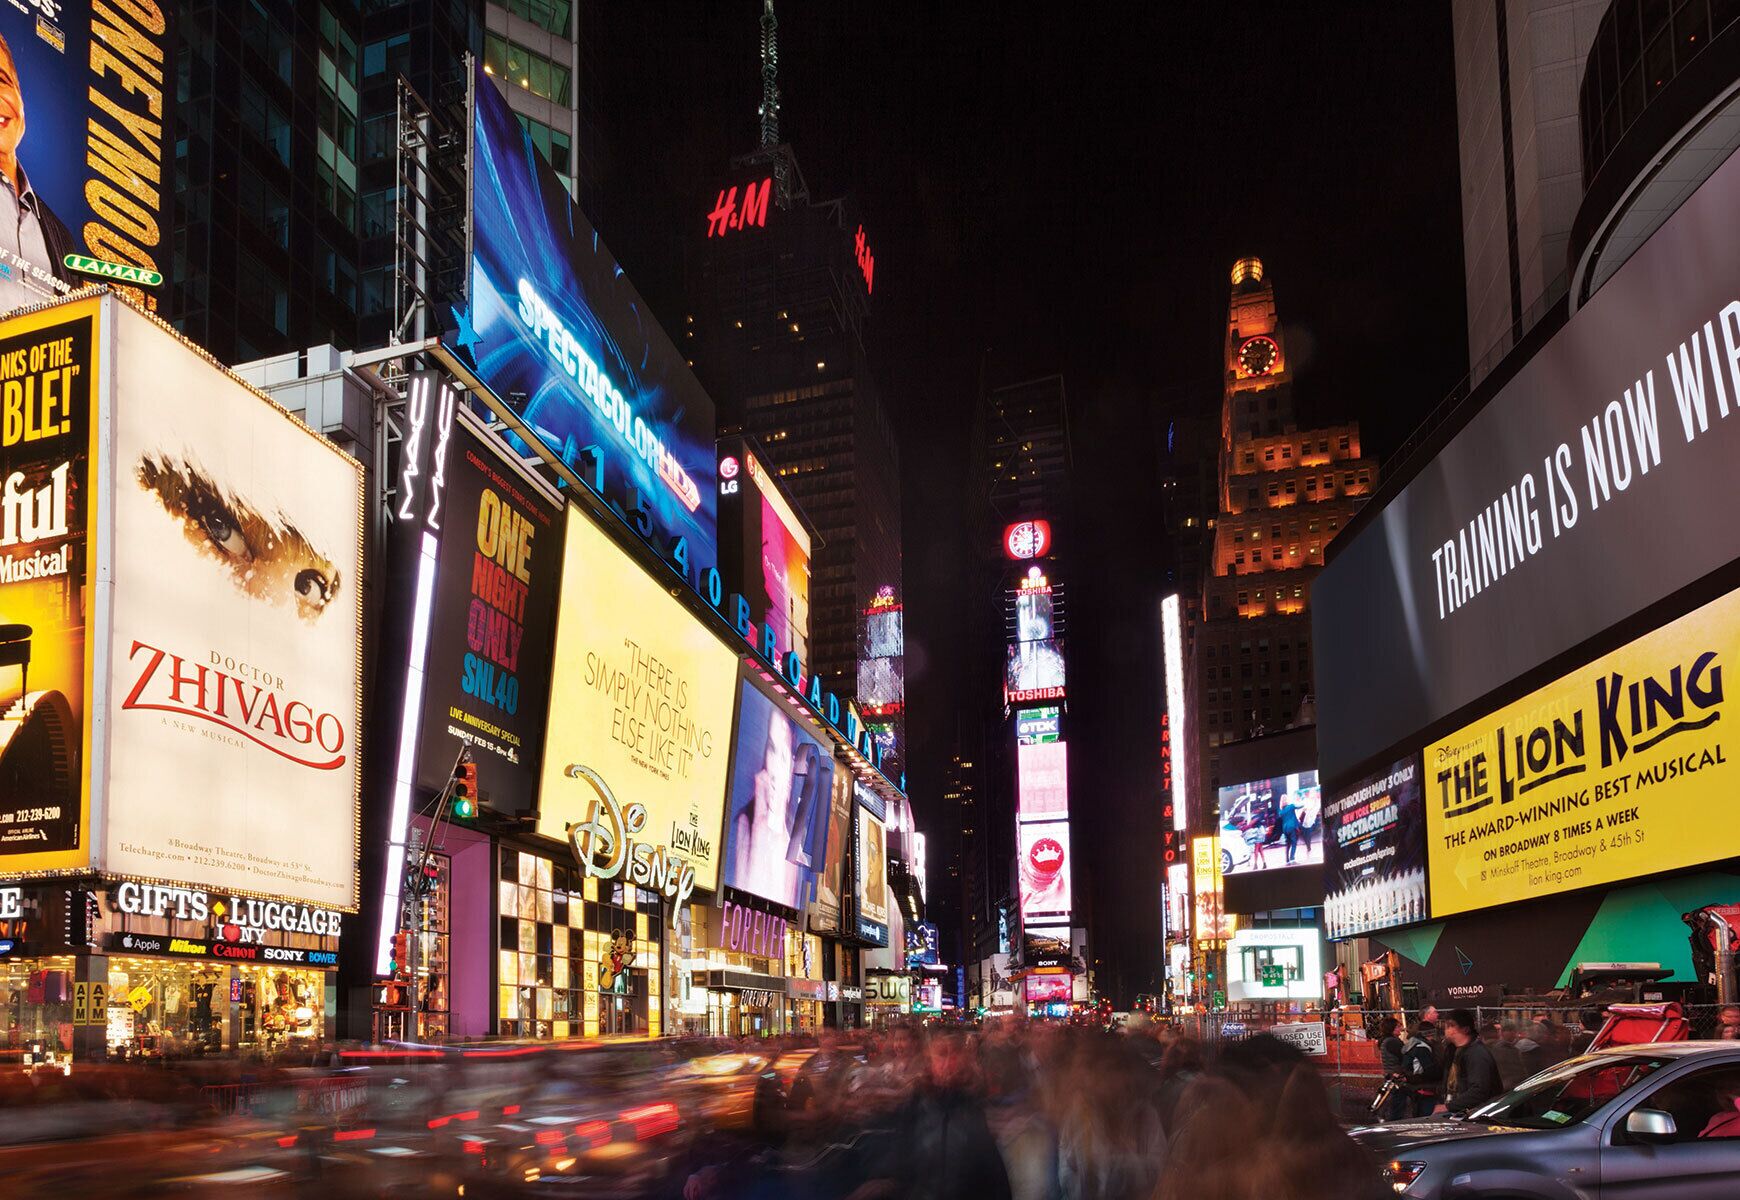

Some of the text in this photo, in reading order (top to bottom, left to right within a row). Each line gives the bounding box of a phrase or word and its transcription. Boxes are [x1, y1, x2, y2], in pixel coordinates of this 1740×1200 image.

[707, 177, 772, 238] H&M
[11, 254, 31, 272] THE
[72, 257, 154, 284] LAMAR
[855, 224, 874, 295] H&M
[0, 337, 73, 379] NKS OF THE
[0, 365, 80, 447] BLE!”
[721, 480, 738, 495] LG
[1432, 473, 1543, 619] TRAINING
[1544, 443, 1578, 538] IS
[1581, 369, 1661, 511] NOW
[476, 488, 535, 586] ONE
[0, 543, 68, 584] Musical
[472, 552, 529, 625] NIGHT
[580, 445, 883, 770] 1540 BROADWAY
[1016, 586, 1052, 596] TOSHIBA
[467, 598, 524, 674] ONLY
[211, 650, 284, 691] DOCTOR
[461, 652, 519, 716] SNL40
[122, 640, 346, 770] ZHIVAGO
[585, 651, 712, 758] SIMPLY NOTHING
[676, 677, 687, 709] IS
[1009, 686, 1065, 701] TOSHIBA
[161, 717, 247, 750] A NEW MUSICAL
[448, 725, 474, 742] SUNDAY
[474, 736, 487, 748] FEB
[449, 706, 520, 747] LIVE ANNIVERSARY SPECIAL
[612, 707, 645, 754] ELSE
[650, 730, 675, 770] LIKE
[1029, 721, 1056, 733] TDK
[1437, 651, 1725, 810] THE LION KING
[648, 763, 660, 776] YORK
[1161, 713, 1171, 790] ERNST
[1164, 805, 1173, 817] &
[1324, 765, 1414, 819] NOW THROUGH MAY 3 ONLY
[1444, 744, 1726, 850] THE AWARD-WINNING BEST MUSICAL
[671, 821, 710, 857] LION KING
[1337, 804, 1399, 843] SPECTACULAR
[1483, 807, 1640, 862] ON BROADWAY 8 TIMES A WEEK
[119, 842, 185, 862] Telecharge.com
[194, 855, 246, 872] 212.239.6200
[175, 838, 212, 856] Broadway
[215, 846, 246, 863] Theatre,
[247, 853, 281, 868] Broadway
[282, 860, 289, 868] at
[1490, 830, 1645, 881] Minskoff Theatre, Broadway & 45th St
[118, 882, 342, 936] GIFTS LUGGAGE
[134, 938, 336, 964] Apple Nikon Canon SONY BOWER
[240, 926, 267, 945] NY
[721, 901, 787, 960] FOREVER
[76, 984, 85, 1020] ATM
[93, 984, 104, 1020] ATM
[1447, 985, 1484, 995] VORNADO
[1304, 1039, 1321, 1047] SIDE
[1307, 1031, 1323, 1039] USE
